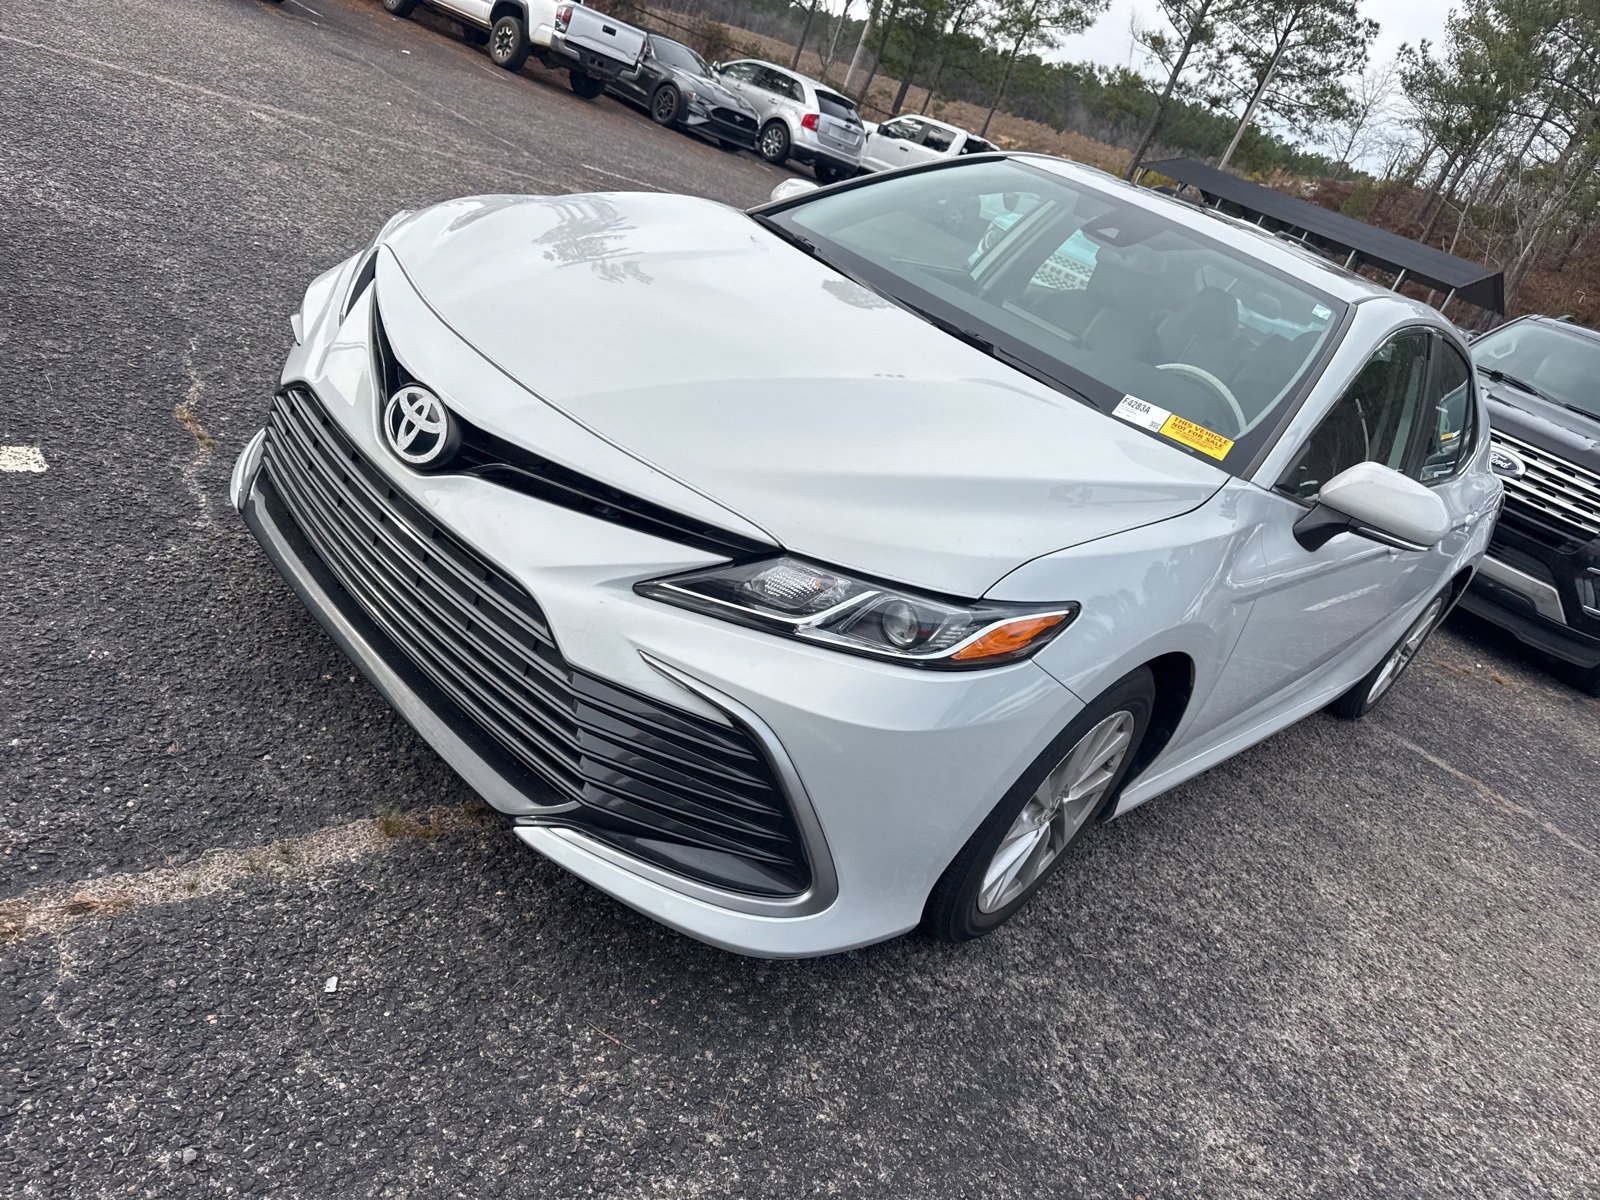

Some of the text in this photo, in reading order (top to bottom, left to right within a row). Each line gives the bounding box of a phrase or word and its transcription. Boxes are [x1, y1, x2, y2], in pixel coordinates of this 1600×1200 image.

[1122, 397, 1151, 414] F4283A
[1171, 422, 1225, 448] NOT FOR SALE
[1173, 417, 1193, 429] THIS
[1194, 427, 1230, 446] VEHICLE
[1491, 452, 1511, 469] Ford
